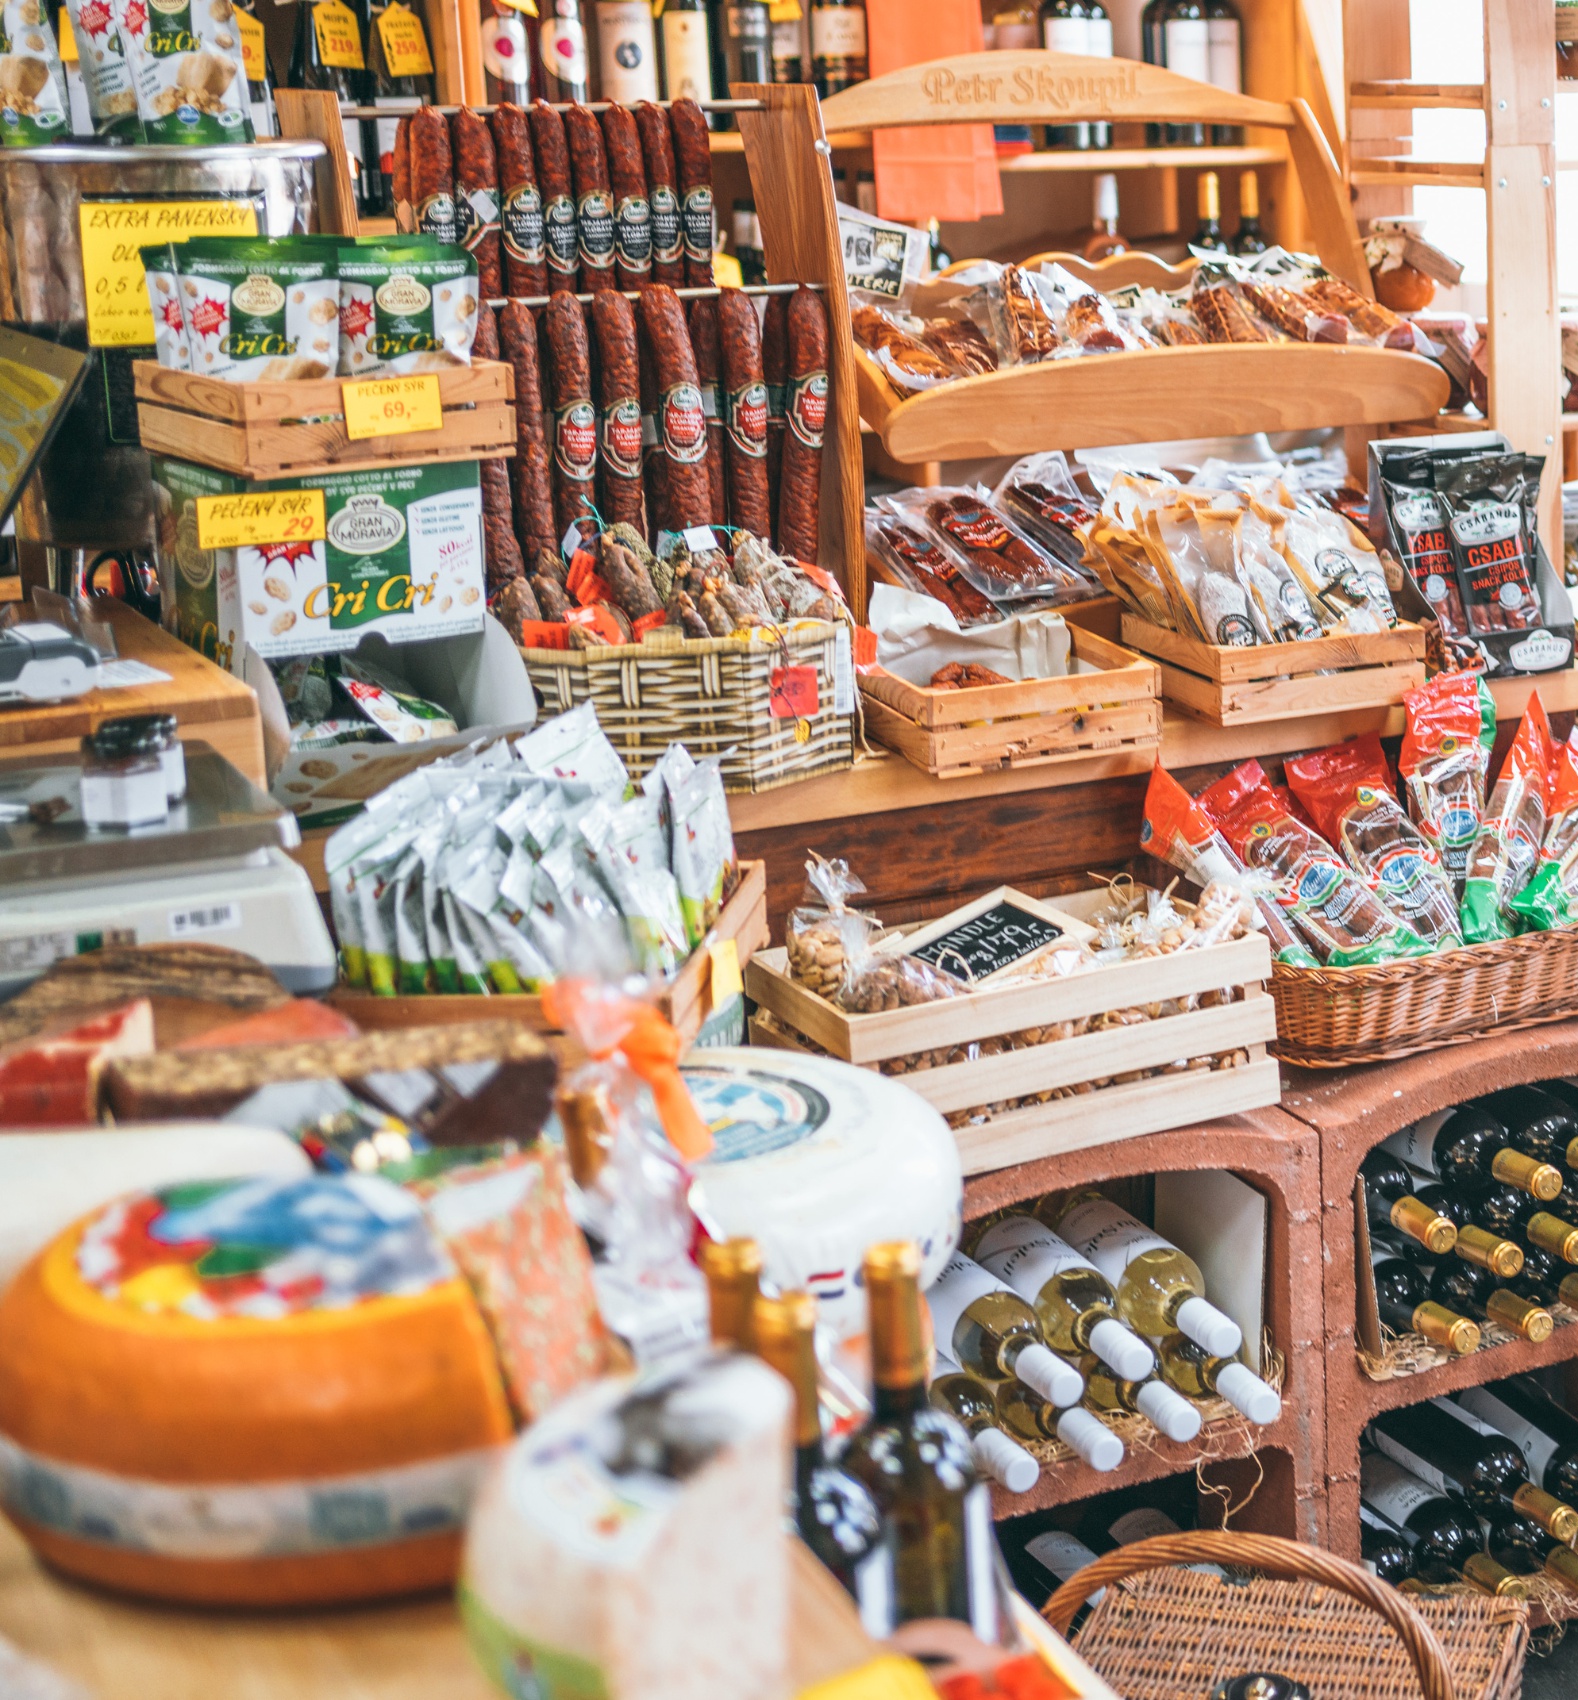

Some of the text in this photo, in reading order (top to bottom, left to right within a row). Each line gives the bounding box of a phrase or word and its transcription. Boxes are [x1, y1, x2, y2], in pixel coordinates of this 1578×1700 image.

[145, 31, 173, 53] Cri
[921, 62, 1143, 113] Petr Skoupil
[90, 208, 150, 229] EXTRA
[248, 264, 279, 276] COTTO
[339, 265, 388, 277] ORMAGGIO
[389, 265, 420, 276] COTTO
[95, 277, 128, 300] 0,5
[219, 333, 301, 356] Cri Cri
[366, 332, 444, 355] Cri Cri
[358, 379, 424, 398] PEČENÝ SÝR
[383, 401, 418, 420] 69,-
[354, 472, 381, 483] COTTO
[382, 470, 394, 479] AL
[394, 468, 423, 479] FORNO
[210, 495, 312, 520] PEČENÝ SÝR
[340, 524, 394, 541] MORAVIA
[350, 516, 383, 529] GRAN
[303, 572, 439, 620] Cri Cri
[915, 911, 1006, 963] MANDLE
